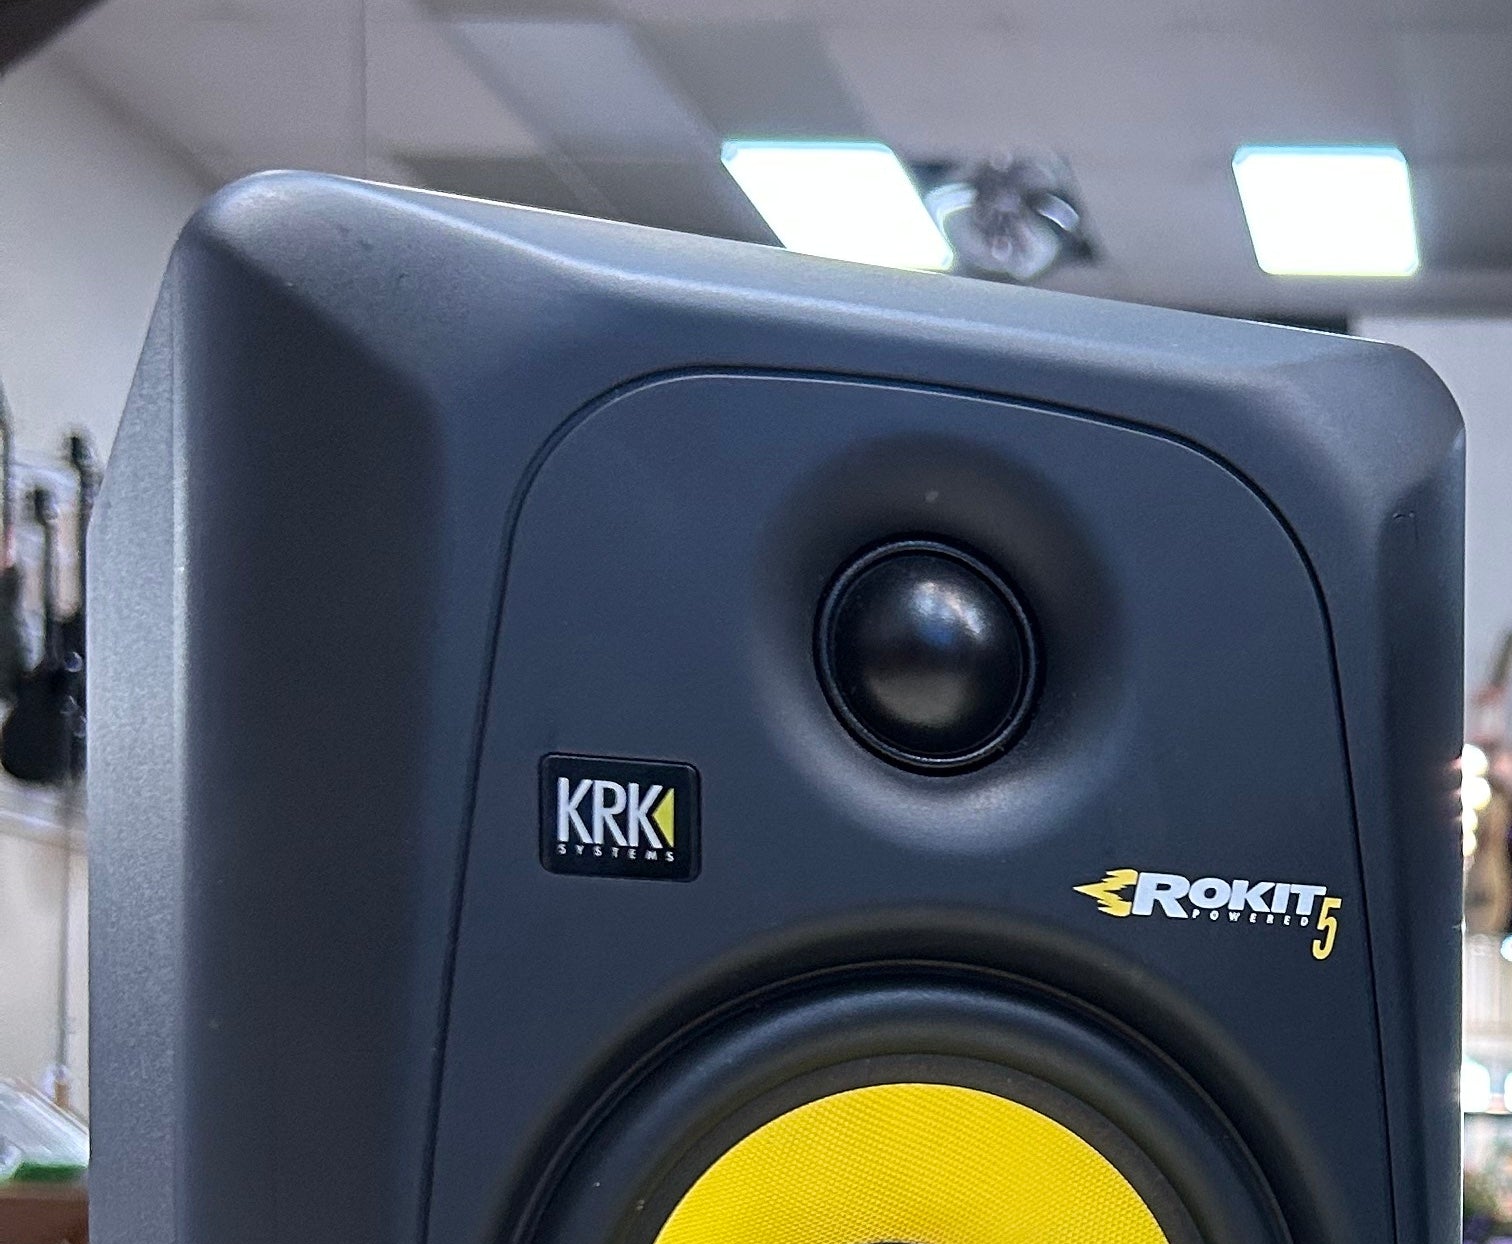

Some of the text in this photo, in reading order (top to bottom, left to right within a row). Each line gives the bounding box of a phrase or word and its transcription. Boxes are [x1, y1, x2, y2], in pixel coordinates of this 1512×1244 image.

[557, 776, 664, 849] KRK
[557, 843, 675, 862] SYSTEMS
[1131, 871, 1343, 960] ROKIT 5
[1191, 907, 1310, 927] POWERED
